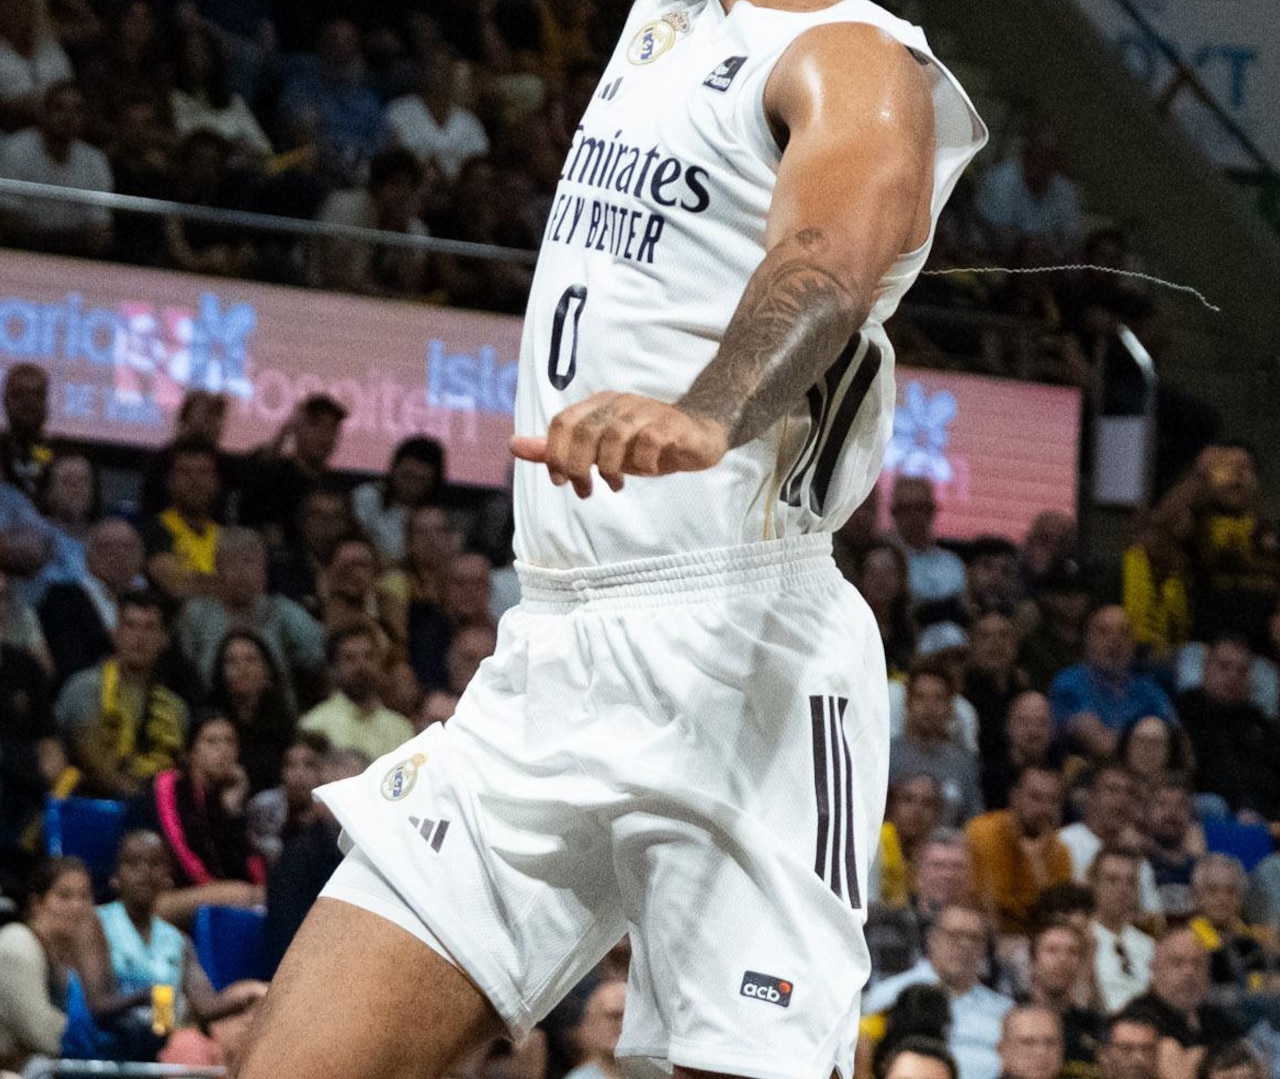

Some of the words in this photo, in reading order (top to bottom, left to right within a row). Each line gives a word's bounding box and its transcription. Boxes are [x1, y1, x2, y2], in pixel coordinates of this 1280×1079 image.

[561, 124, 710, 213] mirates
[585, 200, 665, 264] BETTER
[547, 283, 587, 391] 0
[743, 983, 780, 1002] acb
